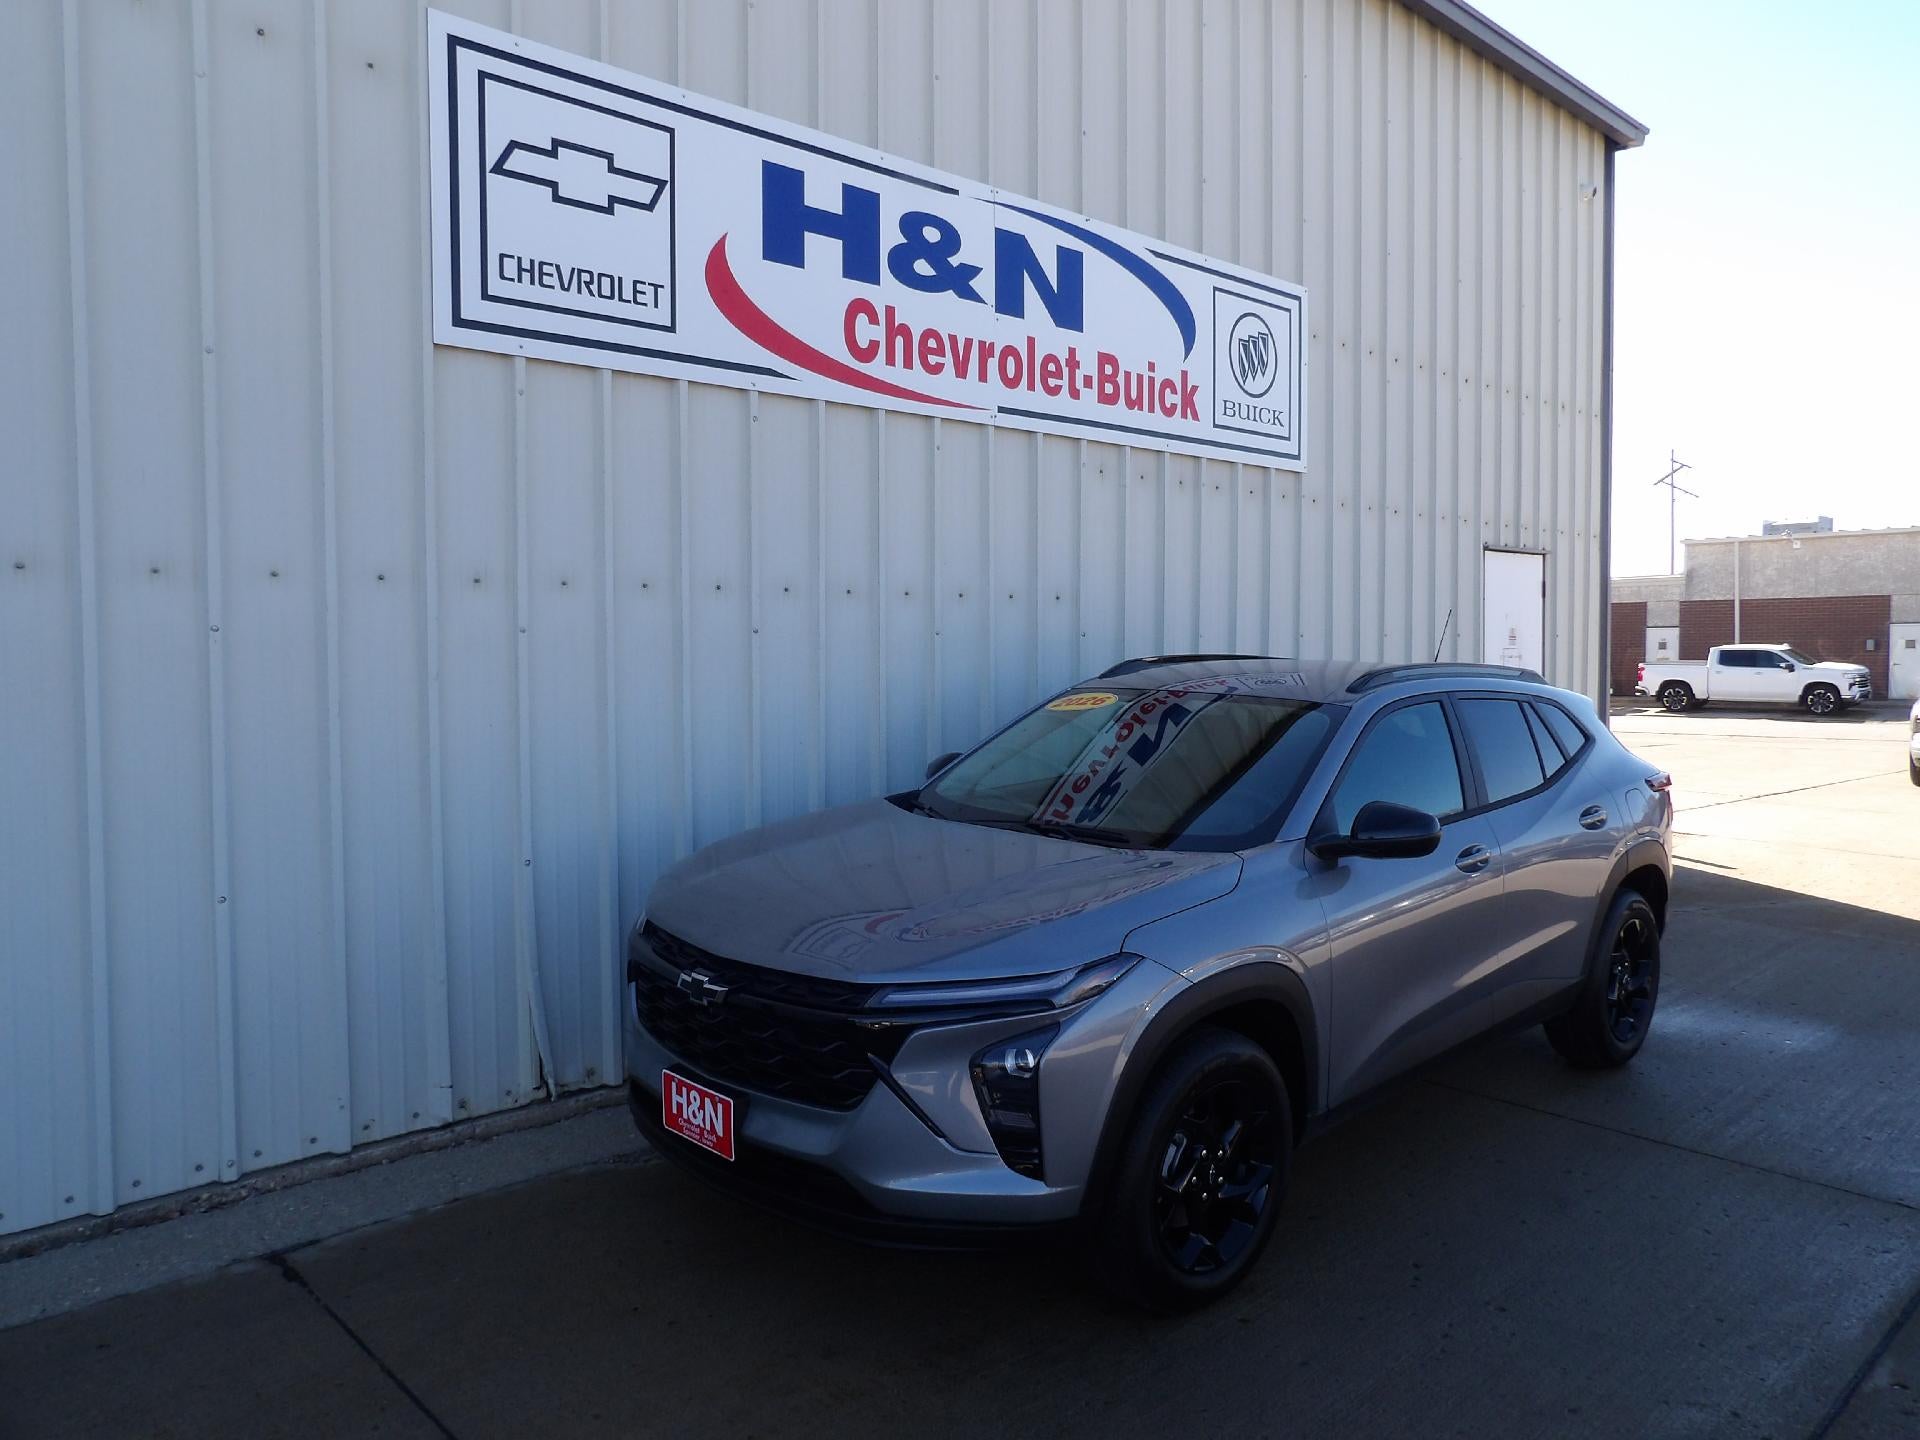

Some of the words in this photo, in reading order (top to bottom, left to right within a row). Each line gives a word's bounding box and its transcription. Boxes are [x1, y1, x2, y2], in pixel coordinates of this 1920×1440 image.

[761, 160, 1084, 333] H&N
[498, 252, 665, 309] CHEVROLET
[843, 297, 1201, 422] Chevrolet-Buick
[1222, 399, 1285, 428] BUICK
[671, 1081, 724, 1137] H&N
